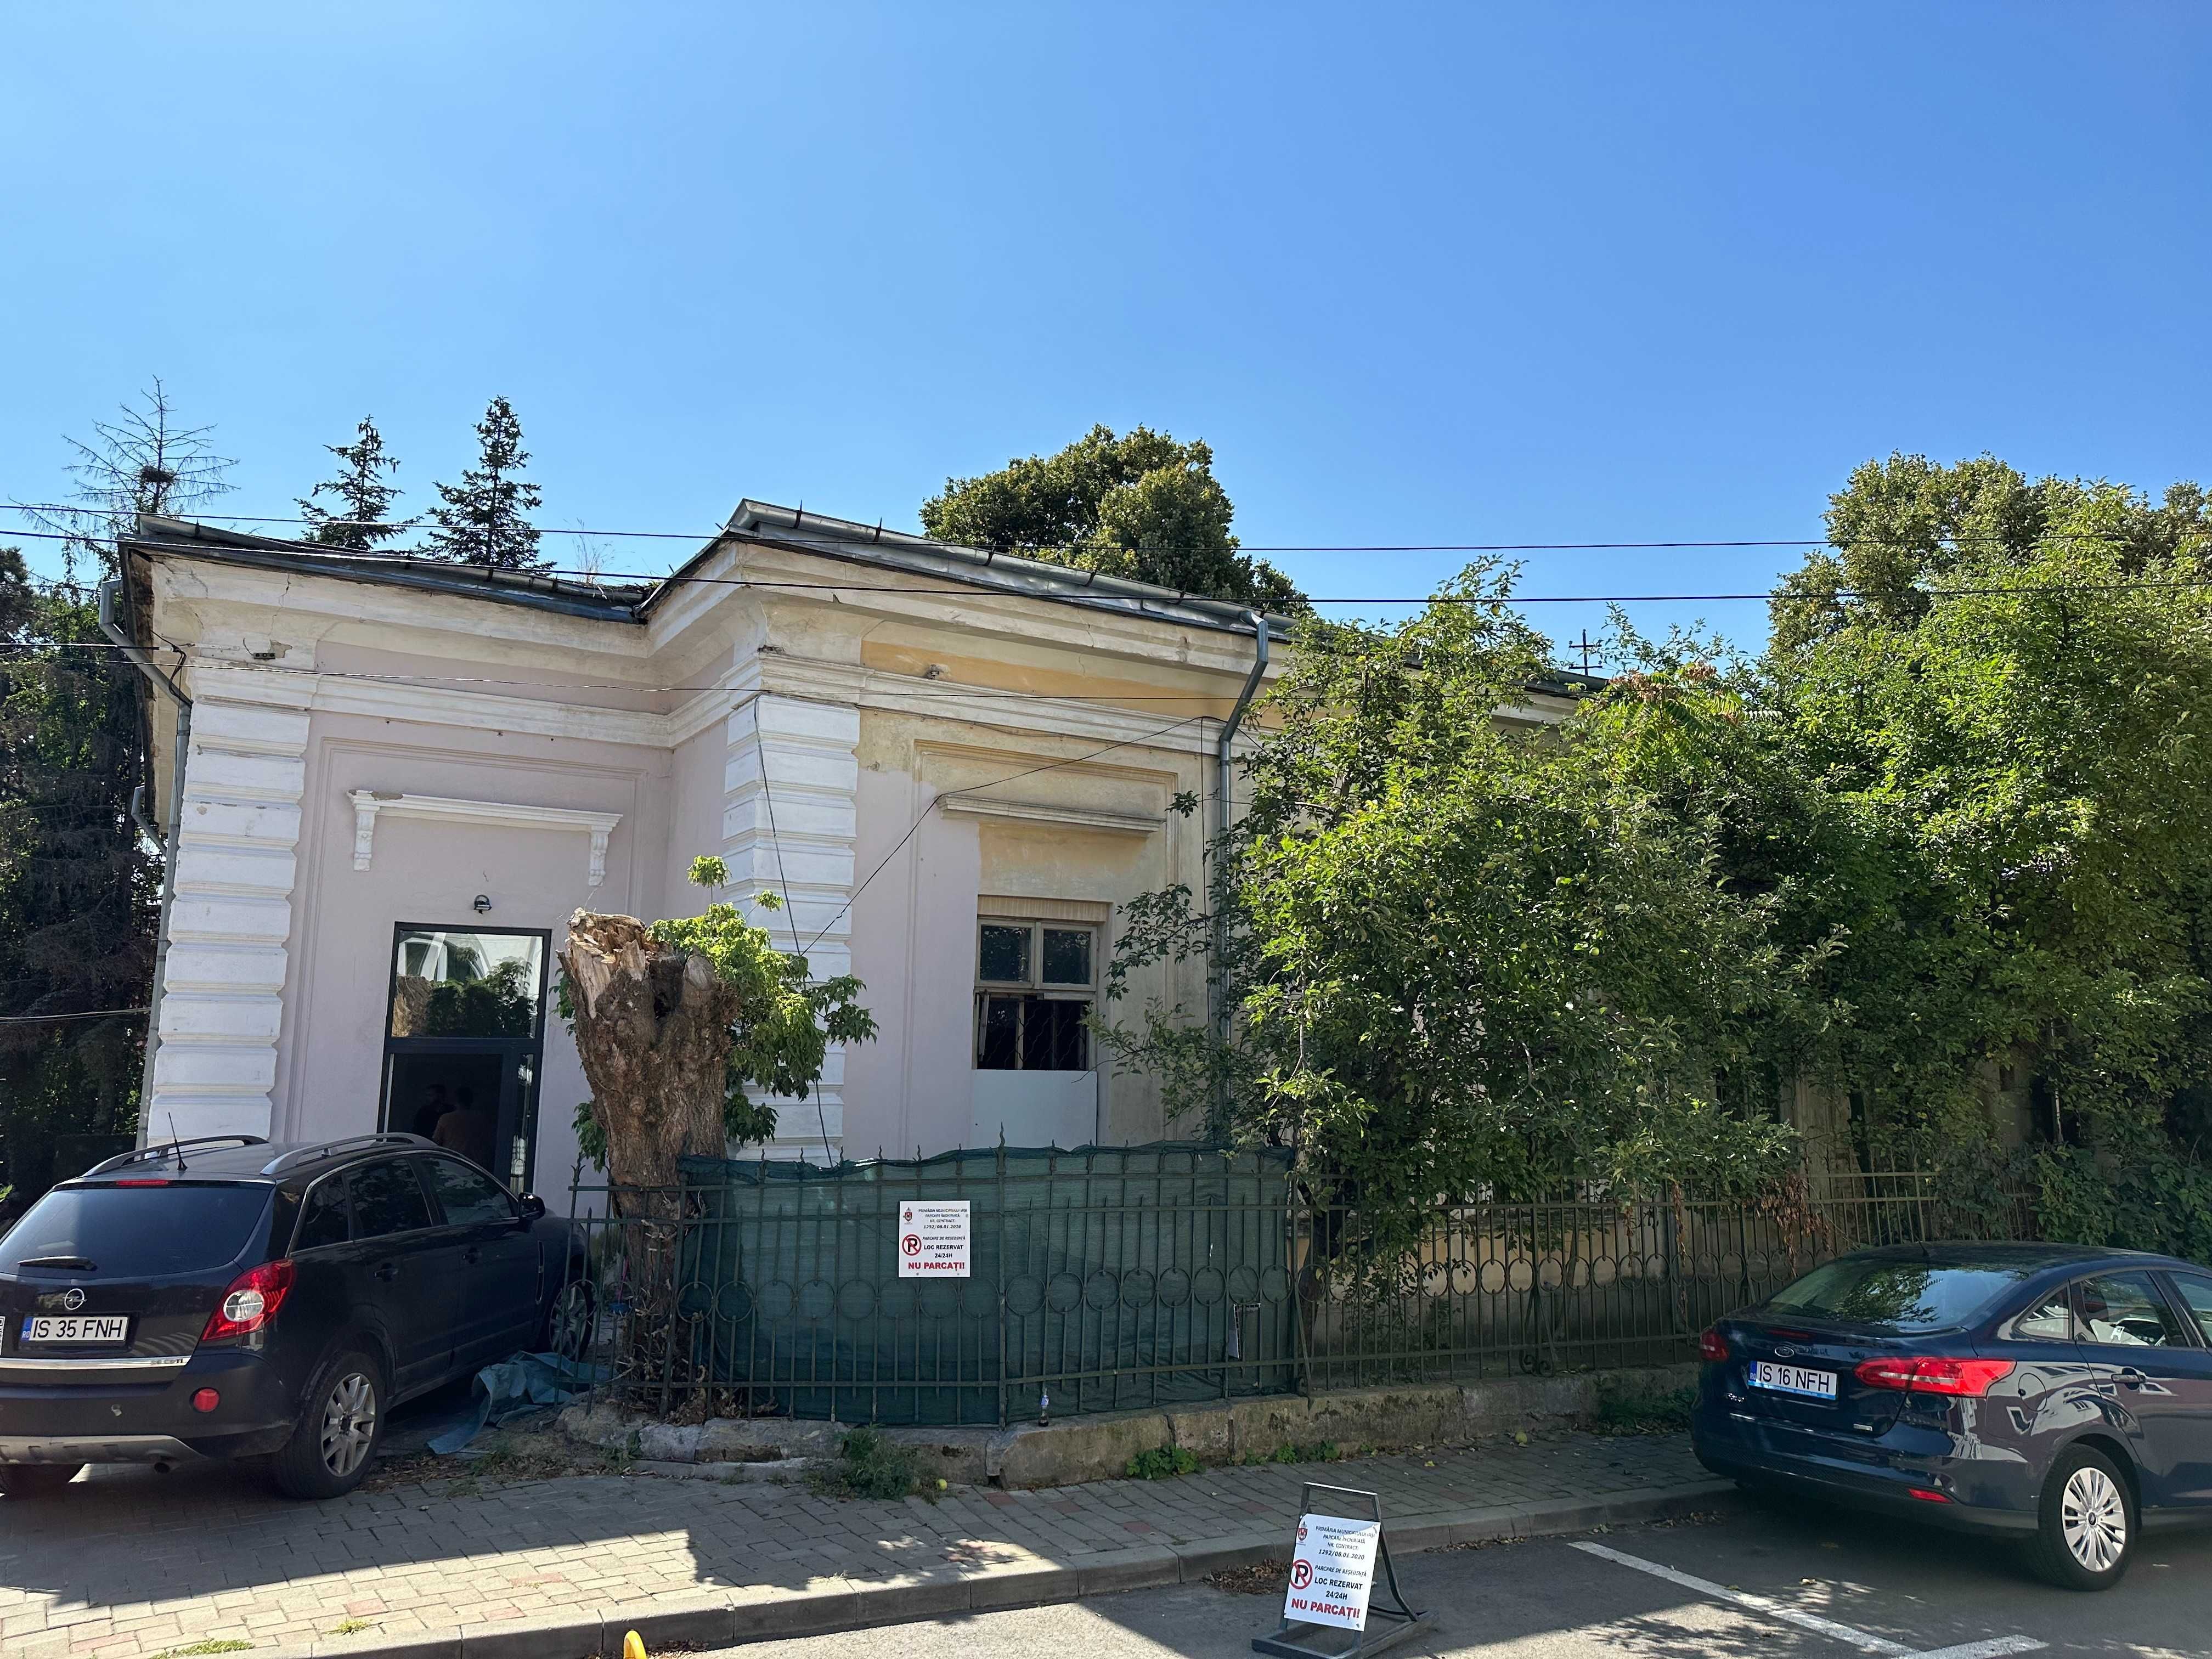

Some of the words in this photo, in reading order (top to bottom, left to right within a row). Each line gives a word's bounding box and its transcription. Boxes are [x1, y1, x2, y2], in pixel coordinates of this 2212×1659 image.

[33, 1320, 50, 1338] IS
[57, 1320, 77, 1338] 35
[82, 1319, 123, 1338] FNH
[1759, 1364, 1773, 1383] IS
[1778, 1367, 1791, 1386] 16
[1796, 1370, 1830, 1393] NFH
[1318, 1549, 1365, 1560] 1292/08.01.2020
[1314, 1577, 1328, 1585] LOC
[1329, 1579, 1363, 1590] REZERVAT
[1325, 1590, 1348, 1600] 24/24H
[1291, 1598, 1308, 1610] NU
